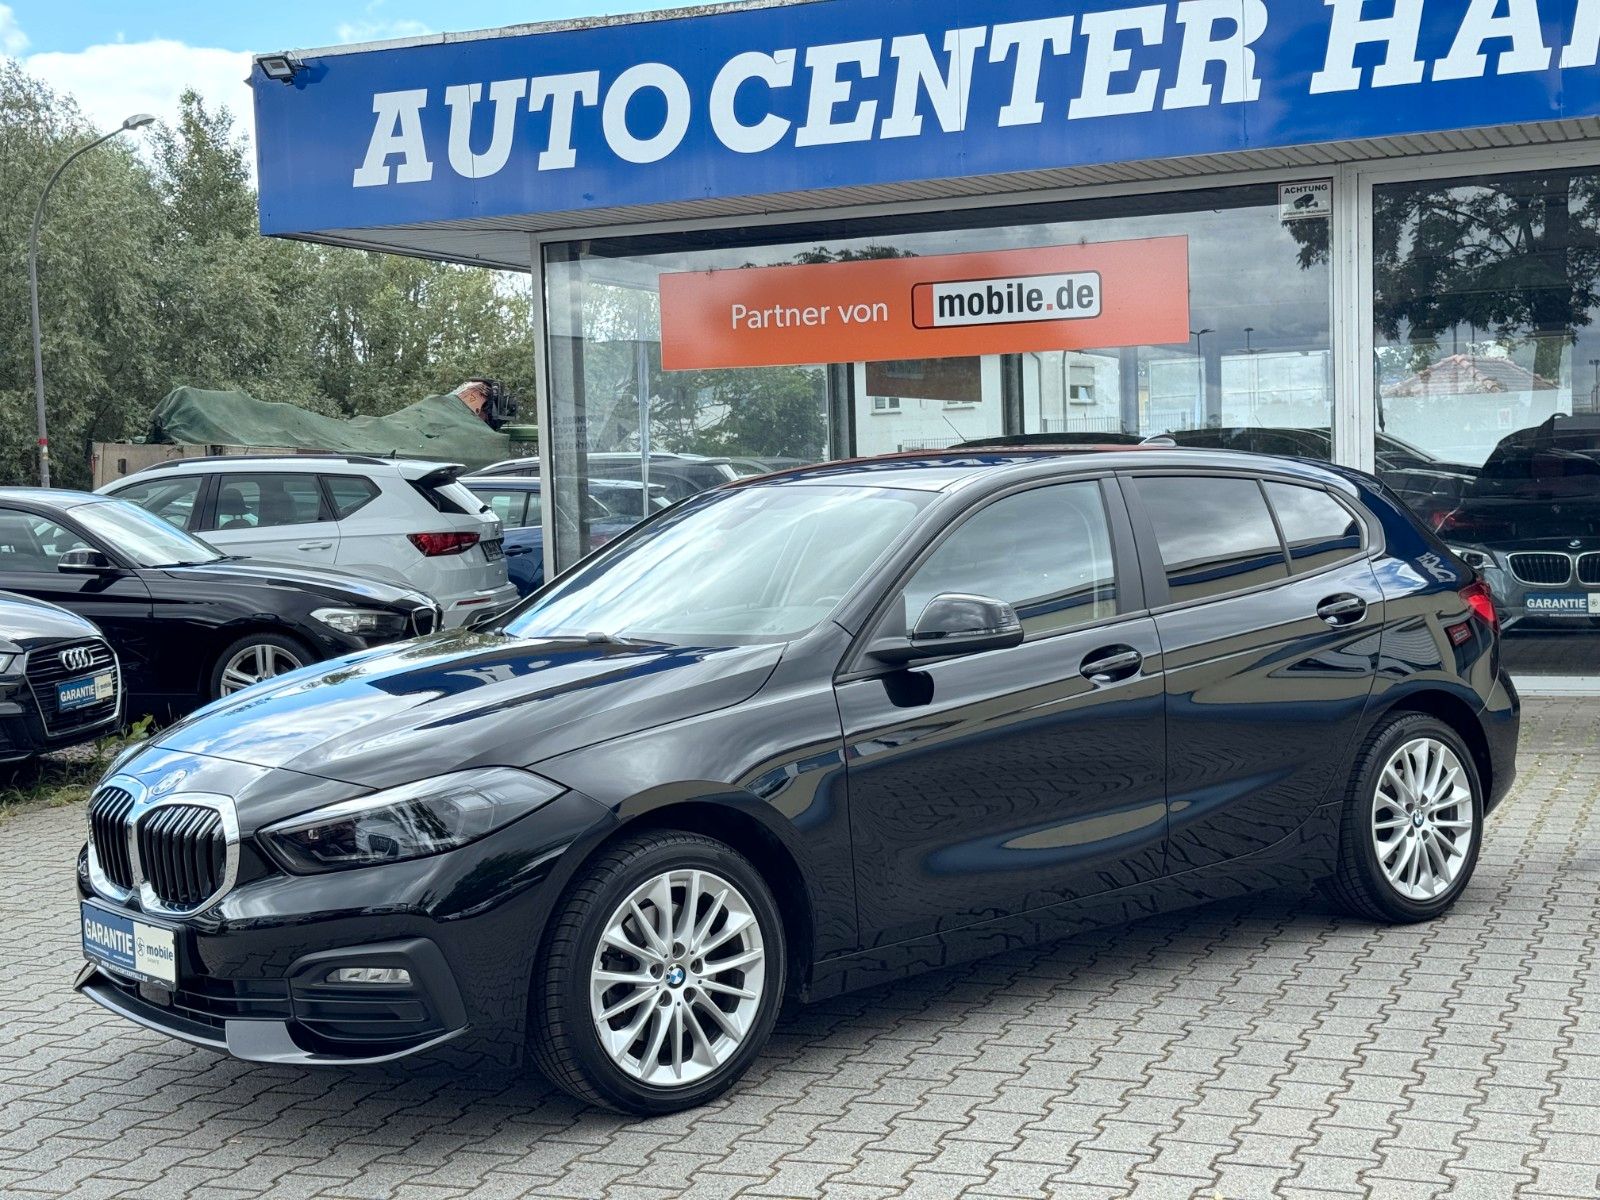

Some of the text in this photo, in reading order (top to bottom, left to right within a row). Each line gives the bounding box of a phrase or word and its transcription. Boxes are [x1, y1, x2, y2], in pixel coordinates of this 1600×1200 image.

[1284, 184, 1328, 194] ACHTUNG
[731, 279, 1095, 330] Partner von mobile.de
[1526, 598, 1587, 609] GARANTIE
[60, 685, 95, 702] GARANTIE
[84, 918, 134, 956] GARANTIE
[146, 944, 174, 961] mobile
